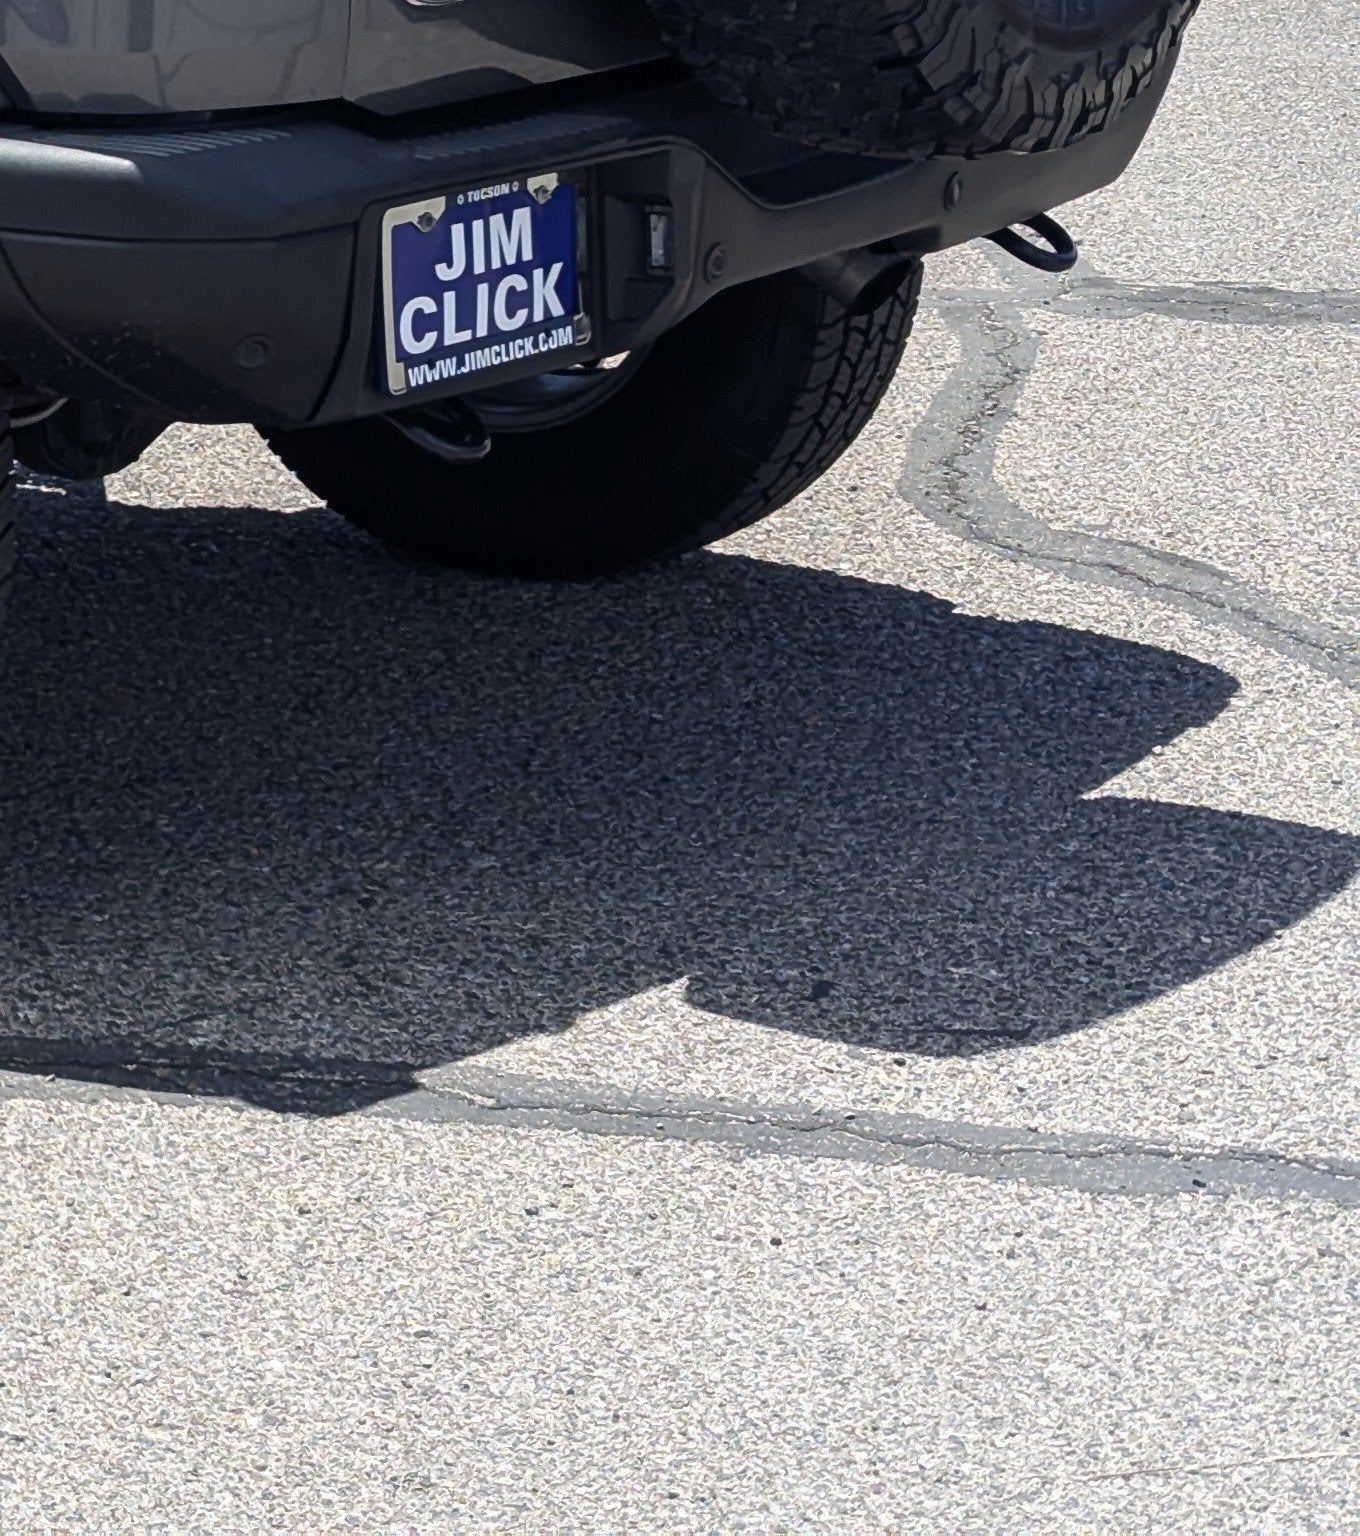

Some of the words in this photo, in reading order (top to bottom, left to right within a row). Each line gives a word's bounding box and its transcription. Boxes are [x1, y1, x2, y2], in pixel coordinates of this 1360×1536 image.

[467, 183, 510, 203] TUCSON
[435, 207, 533, 281] JIM
[400, 262, 565, 354] CLICK
[408, 326, 573, 387] WWW.JIMCLICK.COM
